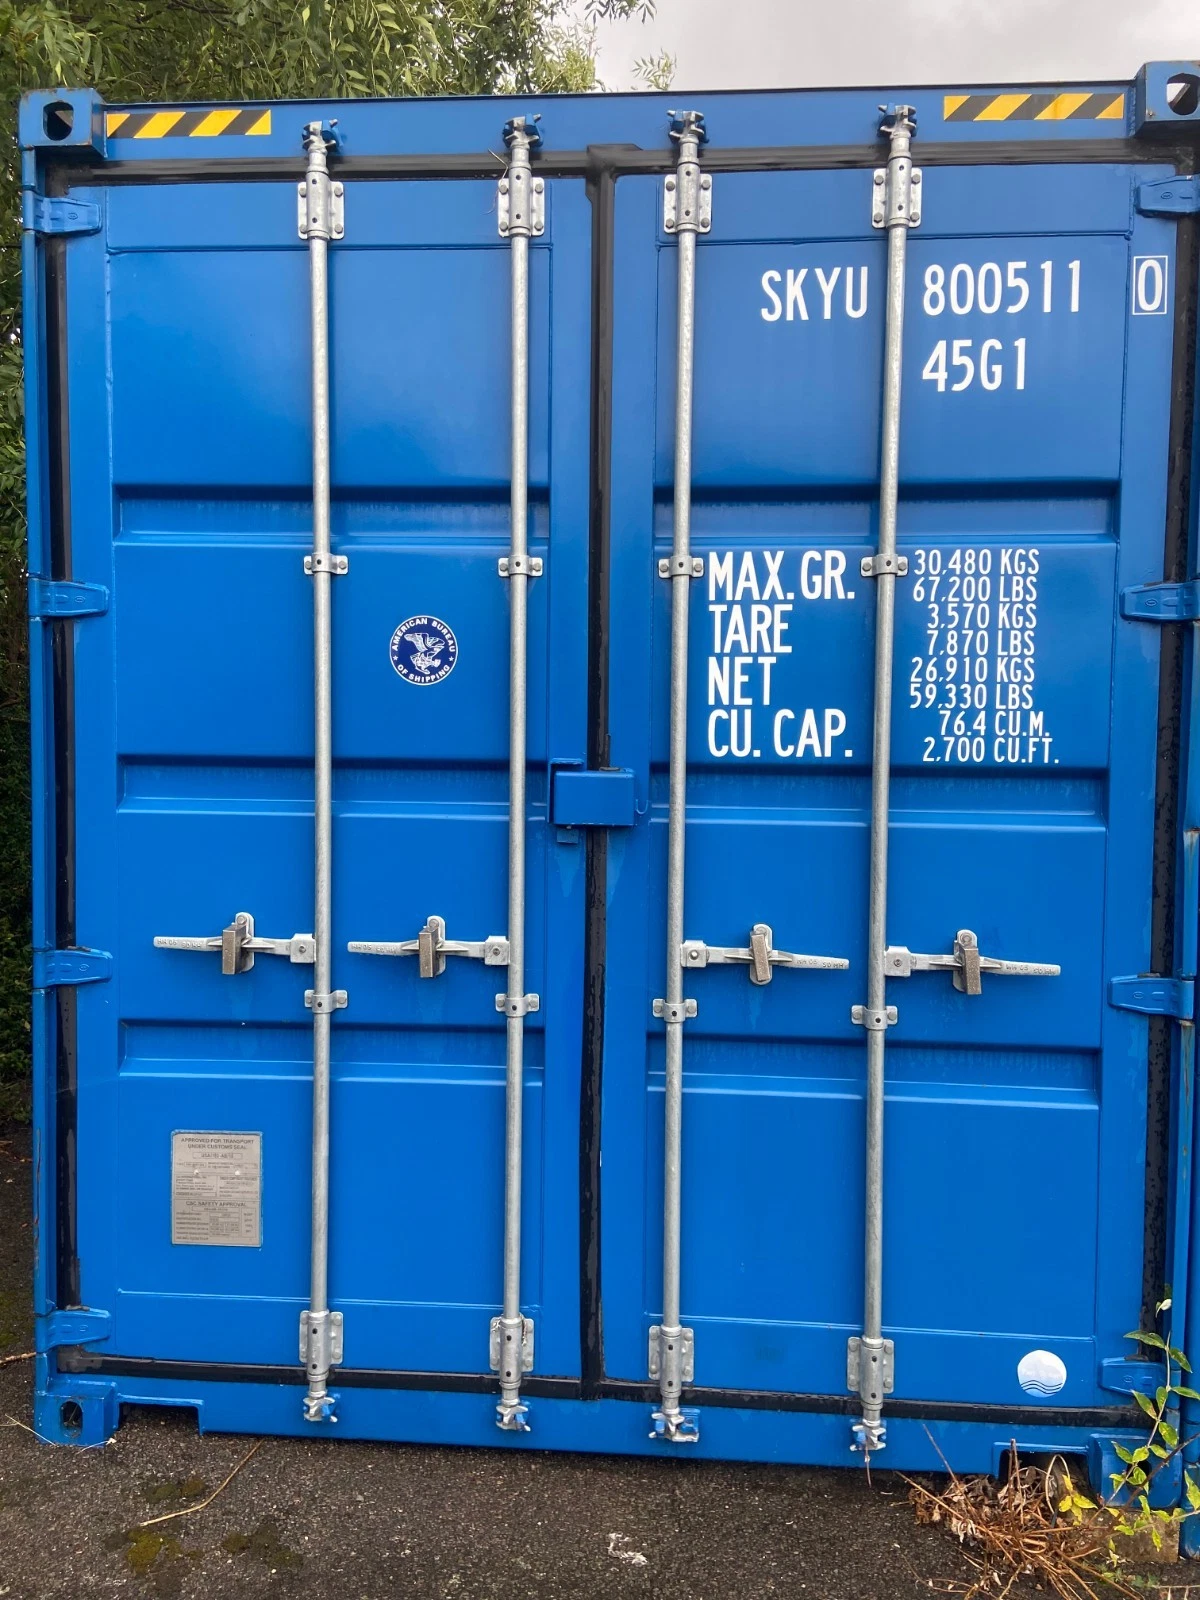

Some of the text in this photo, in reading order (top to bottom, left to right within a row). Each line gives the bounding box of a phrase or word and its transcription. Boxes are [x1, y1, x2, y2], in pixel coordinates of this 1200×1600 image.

[761, 258, 1163, 321] SKYU 800511 0
[921, 338, 1026, 392] 45G1
[914, 548, 1040, 576] 30,480 KGS
[912, 575, 1037, 602] 67,200 LBS
[708, 603, 793, 654] TARE
[927, 602, 1037, 629] 3,570 KGS
[391, 617, 456, 652] AMERICAN BUREAU
[926, 629, 1035, 656] 7,870 LBS
[397, 664, 451, 683] OF SHIPPING
[708, 656, 777, 706] NET
[910, 656, 1035, 683] 26,910 KGS
[910, 683, 1033, 710] 59,330 LBS
[708, 708, 853, 758] CU. CAP.
[939, 710, 986, 736] 76.4
[922, 736, 985, 763] 2,700
